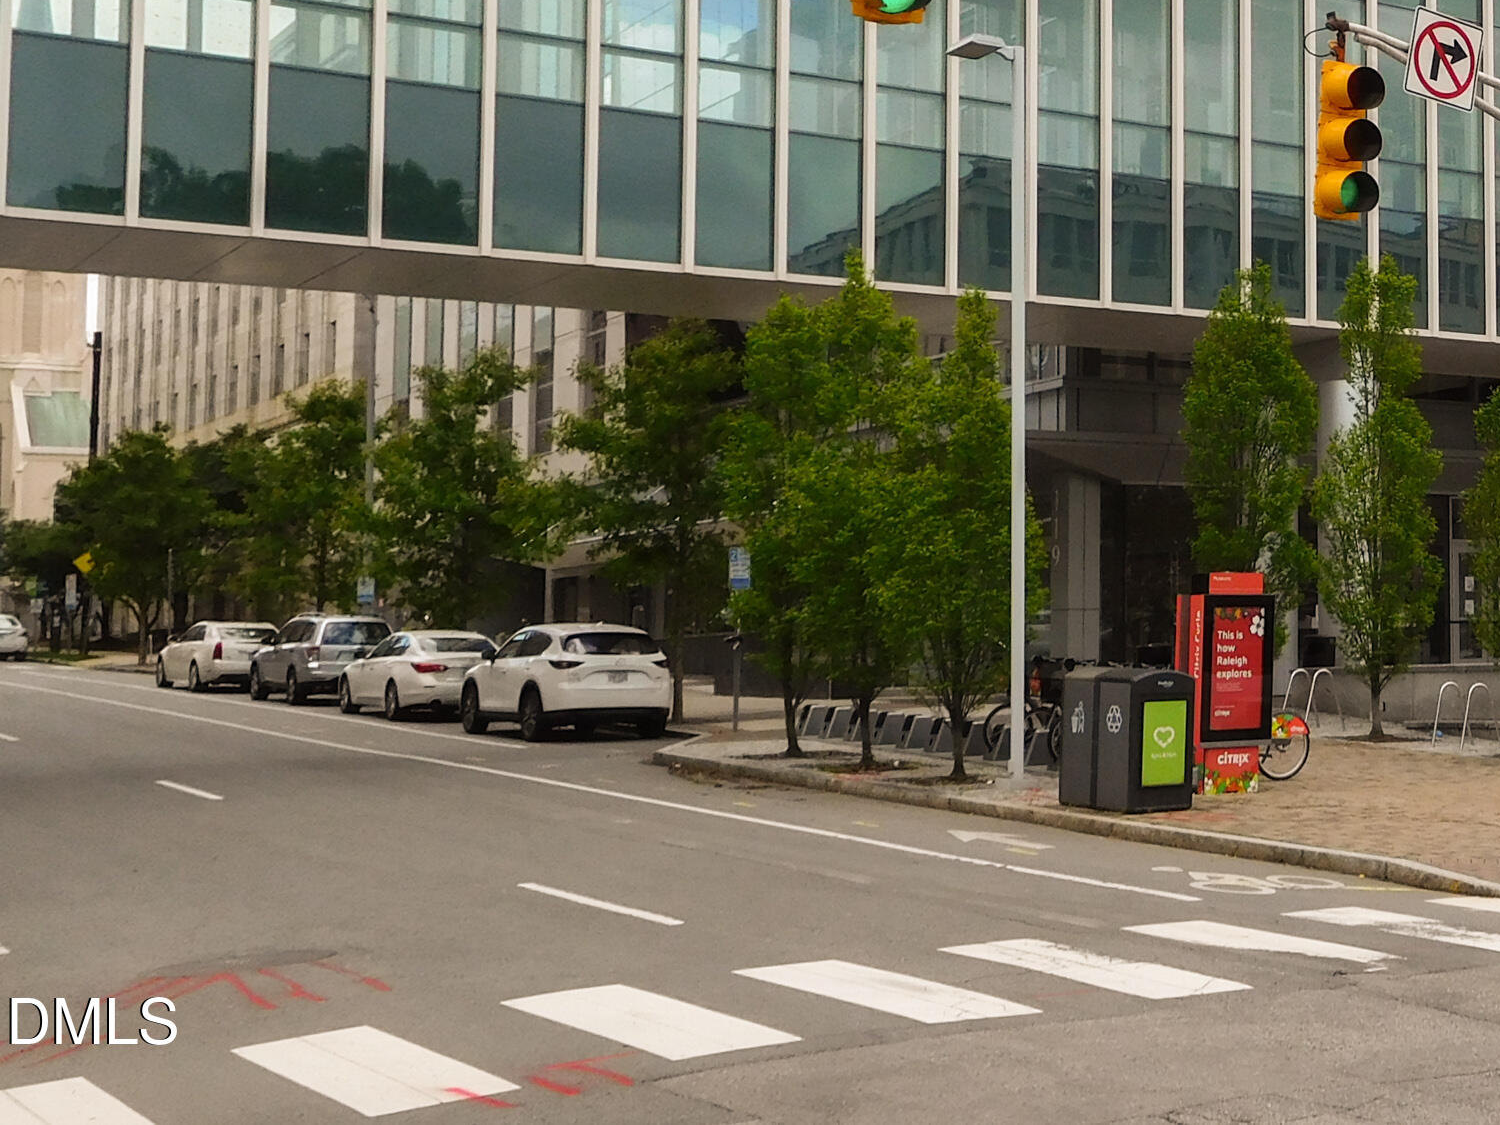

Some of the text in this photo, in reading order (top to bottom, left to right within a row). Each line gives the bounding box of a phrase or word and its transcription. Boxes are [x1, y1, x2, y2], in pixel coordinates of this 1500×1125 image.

[1217, 630, 1243, 640] This is
[1216, 644, 1236, 653] how
[1216, 656, 1248, 667] Raleigh
[1216, 669, 1253, 680] explores
